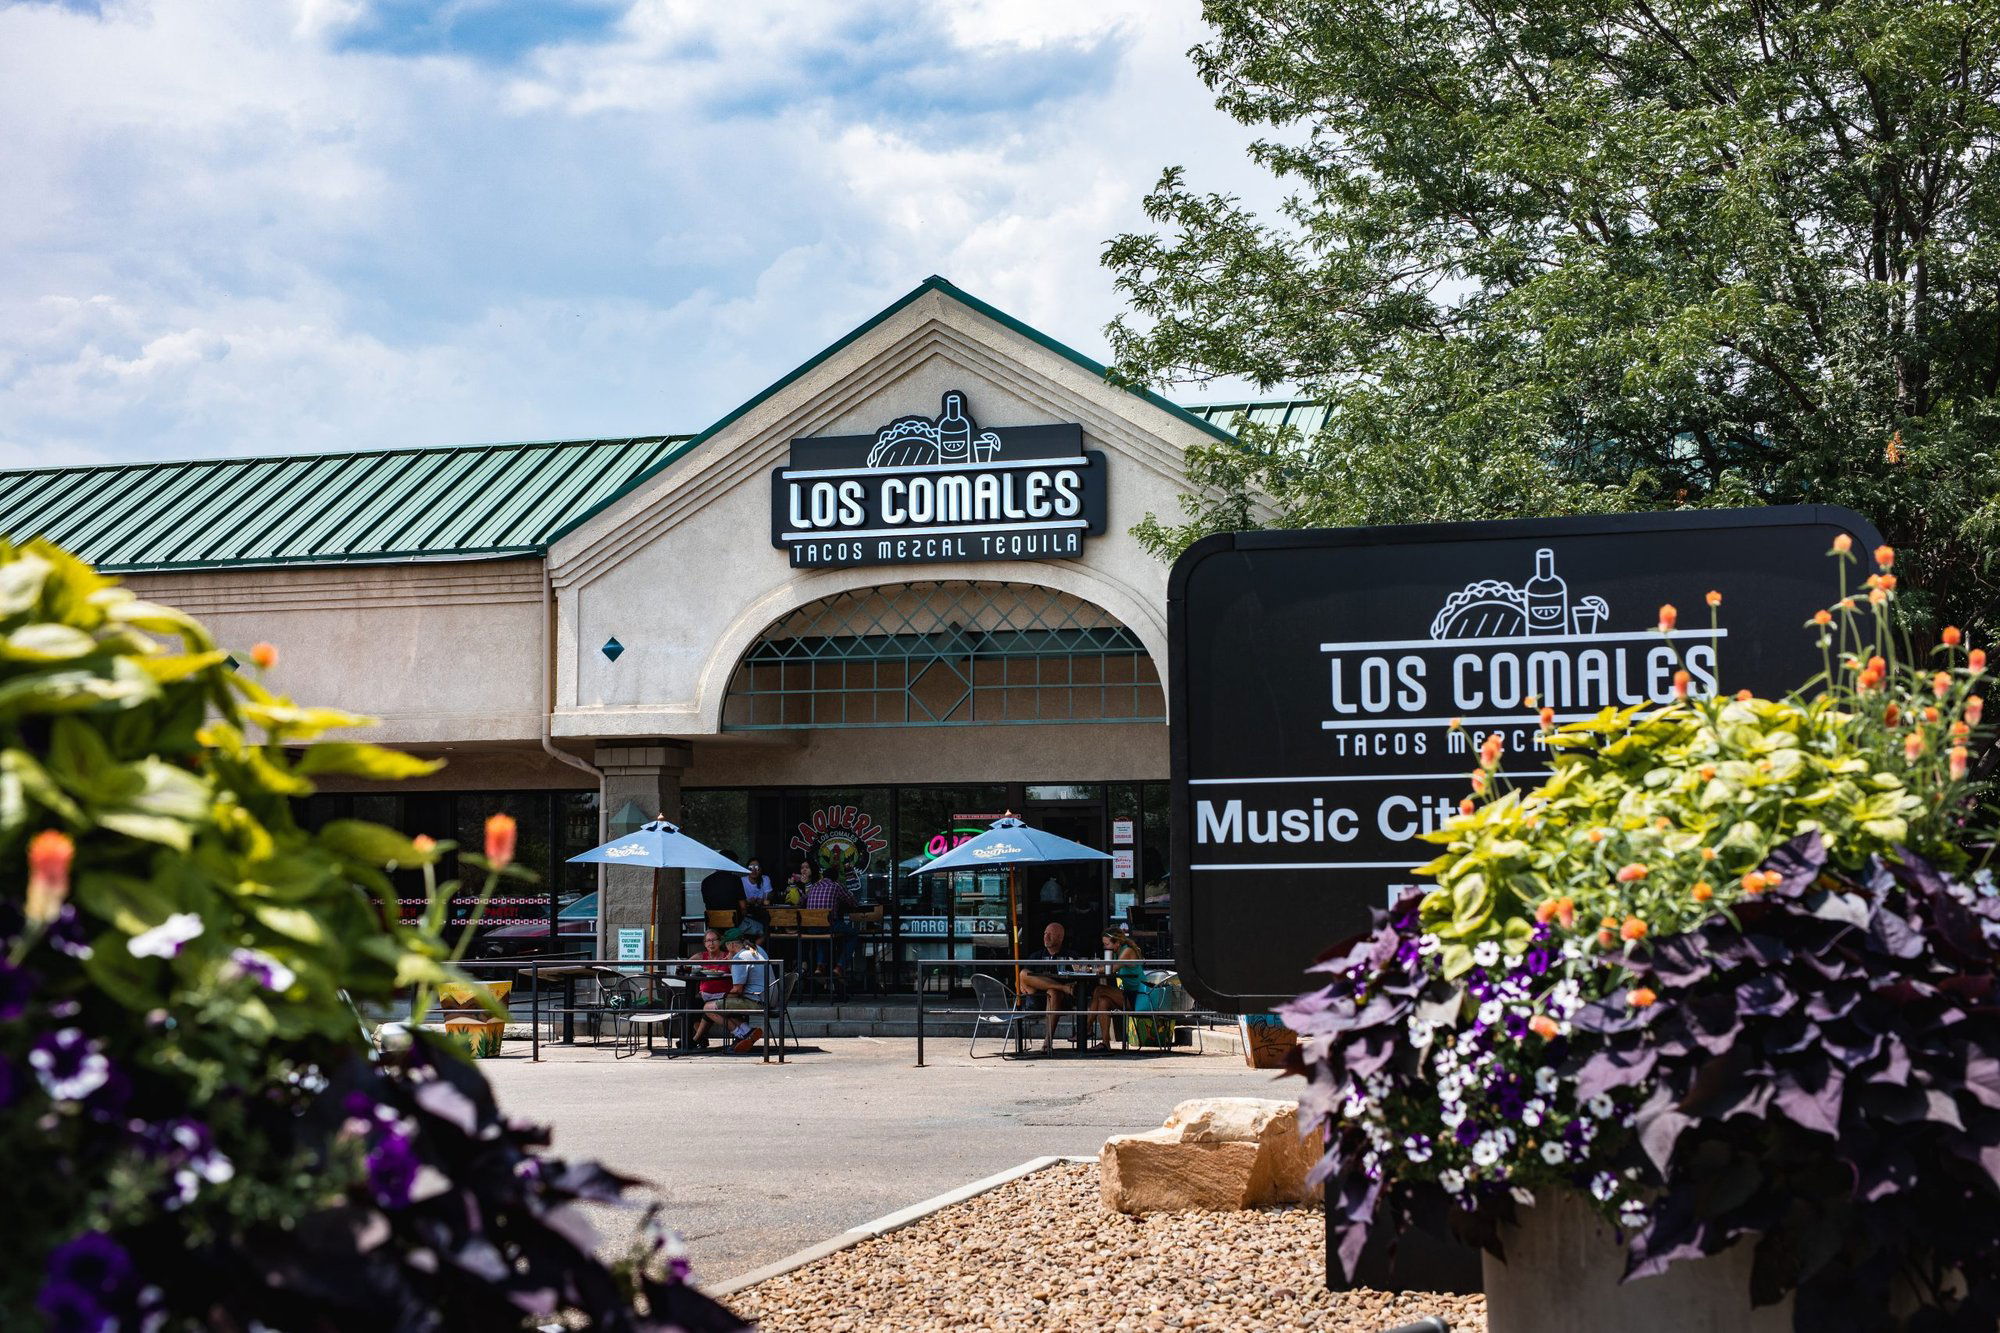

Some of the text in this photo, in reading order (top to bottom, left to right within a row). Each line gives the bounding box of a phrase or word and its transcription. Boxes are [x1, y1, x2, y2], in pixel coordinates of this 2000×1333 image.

[790, 470, 1082, 529] LOS COMALES
[794, 533, 1078, 563] TACOS MEZCAL TEQUILA
[1331, 645, 1718, 714] LOS COMALES
[1336, 732, 1427, 757] TACOS
[790, 805, 888, 853] TAQUERIA
[1196, 795, 1466, 844] Music Cit
